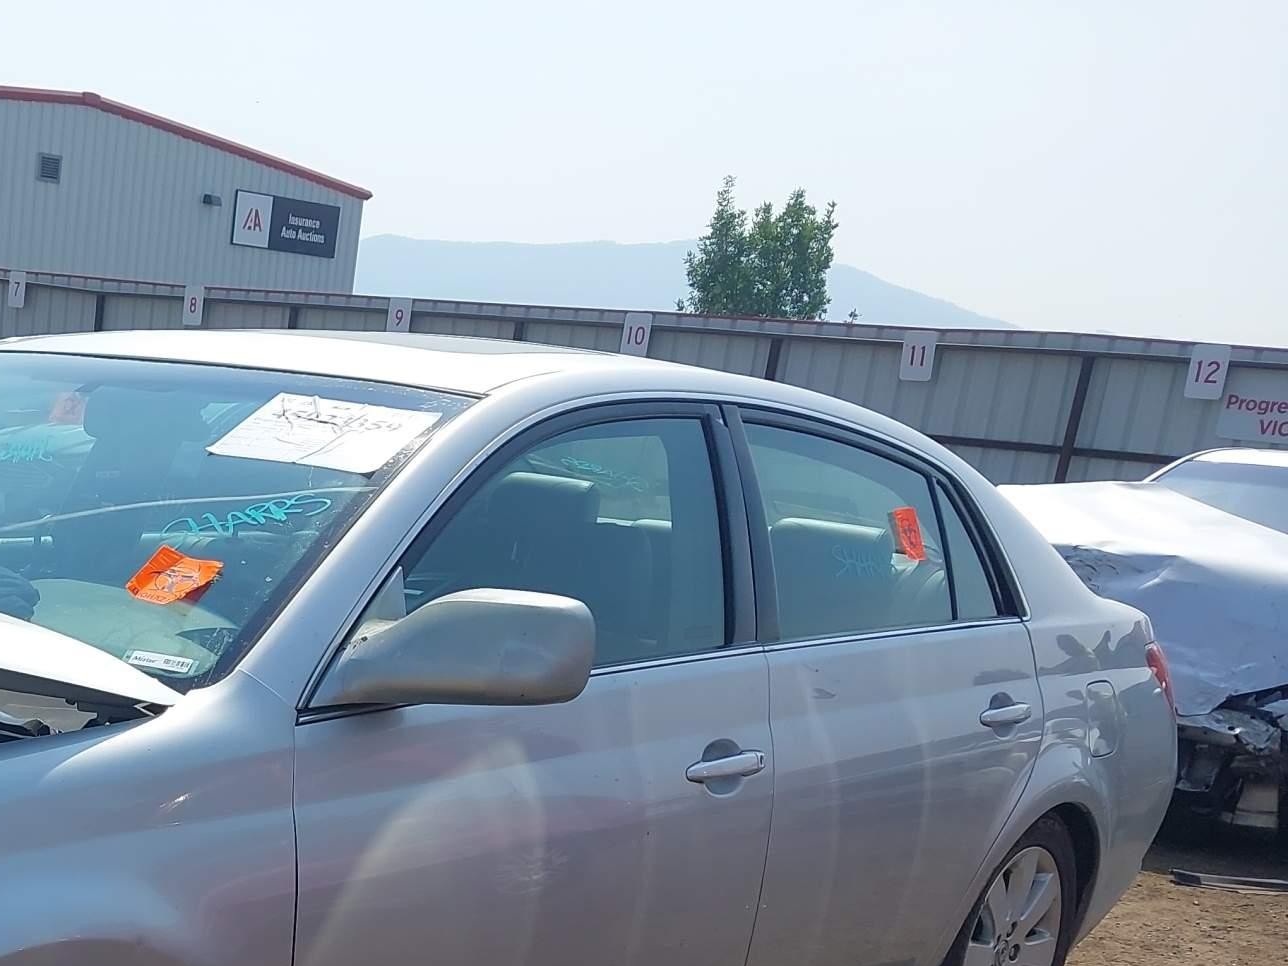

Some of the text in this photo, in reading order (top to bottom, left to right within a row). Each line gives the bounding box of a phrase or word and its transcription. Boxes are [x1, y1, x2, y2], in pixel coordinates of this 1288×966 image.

[288, 213, 321, 229] Insurance
[280, 226, 325, 244] Auto Auctions
[14, 281, 22, 297] 7
[189, 296, 198, 314] 8
[395, 308, 404, 327] 9
[626, 326, 646, 346] 10
[909, 344, 927, 367] 11
[1194, 359, 1221, 384] 12
